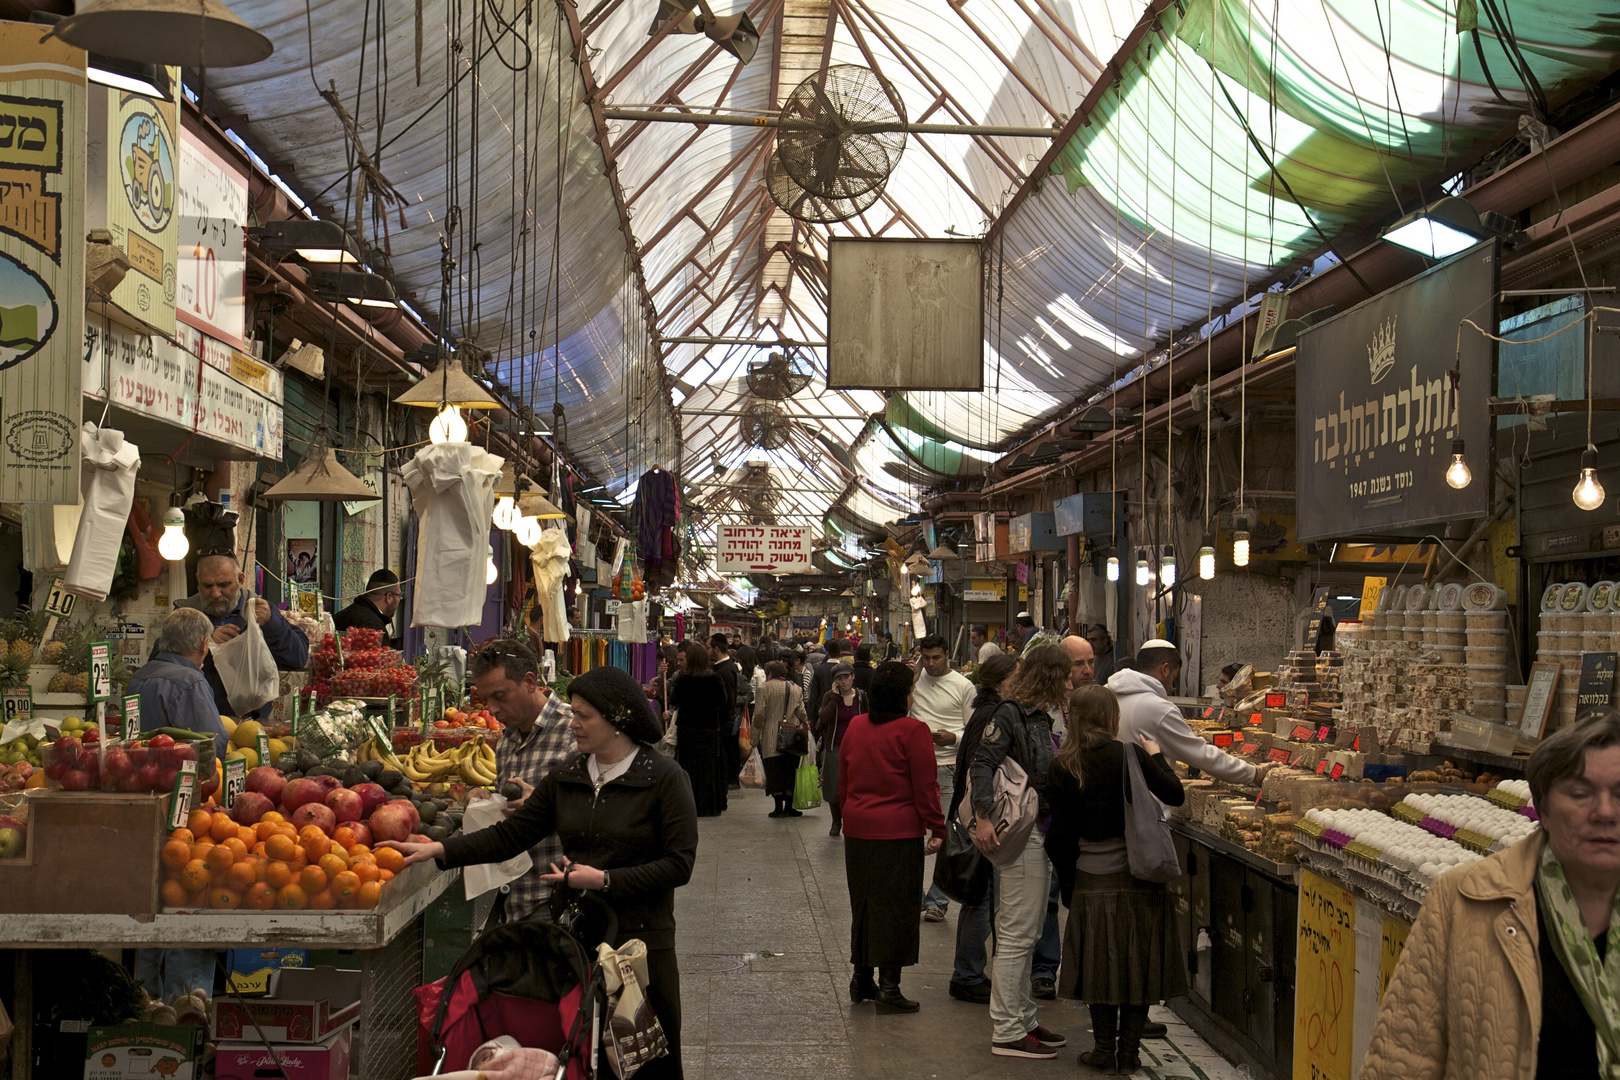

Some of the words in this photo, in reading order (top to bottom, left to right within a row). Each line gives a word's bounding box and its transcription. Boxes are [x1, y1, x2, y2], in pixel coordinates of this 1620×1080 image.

[221, 218, 227, 247] 3
[193, 241, 216, 321] 10
[1370, 474, 1392, 495] בשנת
[1395, 469, 1413, 489] נוסד
[1350, 480, 1367, 498] 1947
[723, 527, 765, 538] לרחוב
[770, 528, 806, 538] יציאה
[728, 540, 763, 550] יהודה
[768, 540, 802, 550] מחנה
[721, 552, 764, 563] העירקי
[770, 552, 807, 564] ולשוק
[49, 590, 74, 614] 10
[94, 662, 101, 695] 2
[101, 663, 109, 680] 50
[17, 699, 29, 711] 00
[228, 779, 235, 809] 6
[237, 981, 261, 989] ערבה
